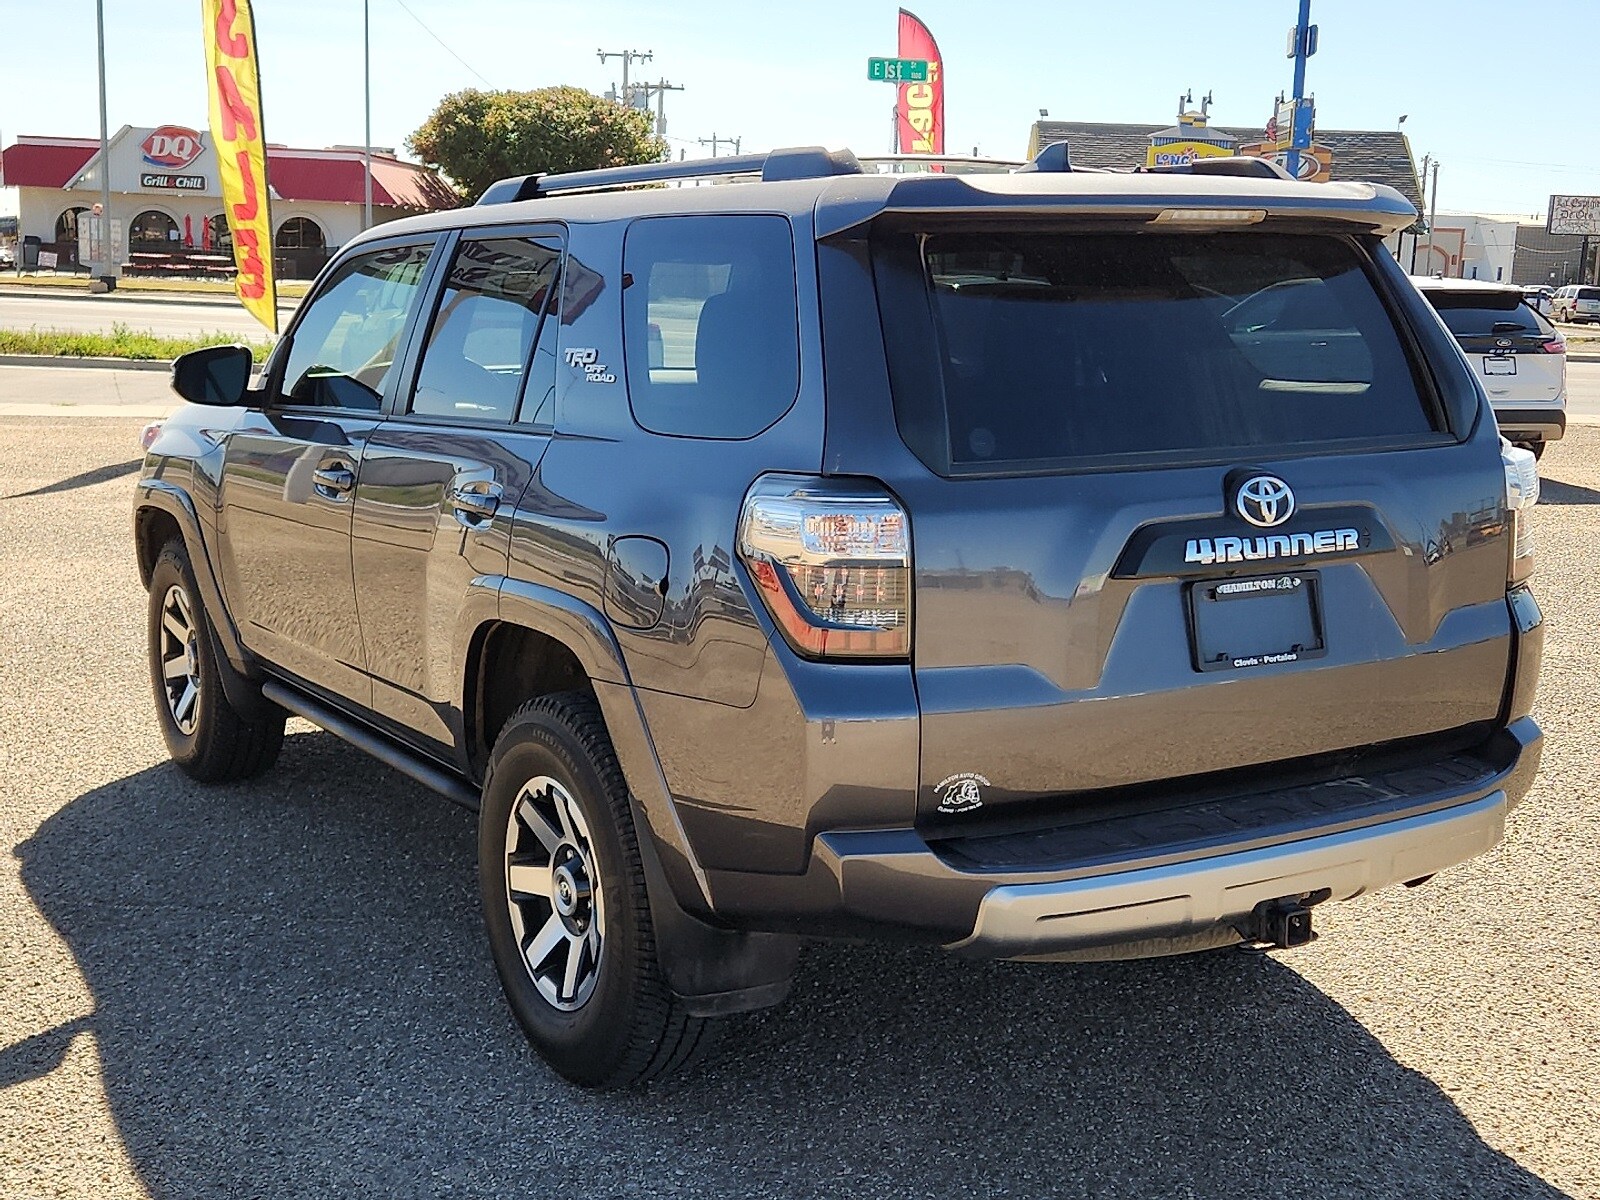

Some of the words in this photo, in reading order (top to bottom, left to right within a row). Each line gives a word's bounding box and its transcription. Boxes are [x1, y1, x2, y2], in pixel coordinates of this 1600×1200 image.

[874, 62, 880, 76] E
[884, 61, 902, 79] 1st
[150, 135, 193, 160] DQ
[143, 175, 168, 187] Grill
[175, 177, 202, 188] Chill
[565, 347, 597, 367] TRD
[584, 364, 607, 374] OFF
[586, 373, 616, 383] ROAD
[1222, 579, 1276, 594] HAMILTON
[1233, 657, 1259, 667] Clovis
[1263, 653, 1298, 664] Portales
